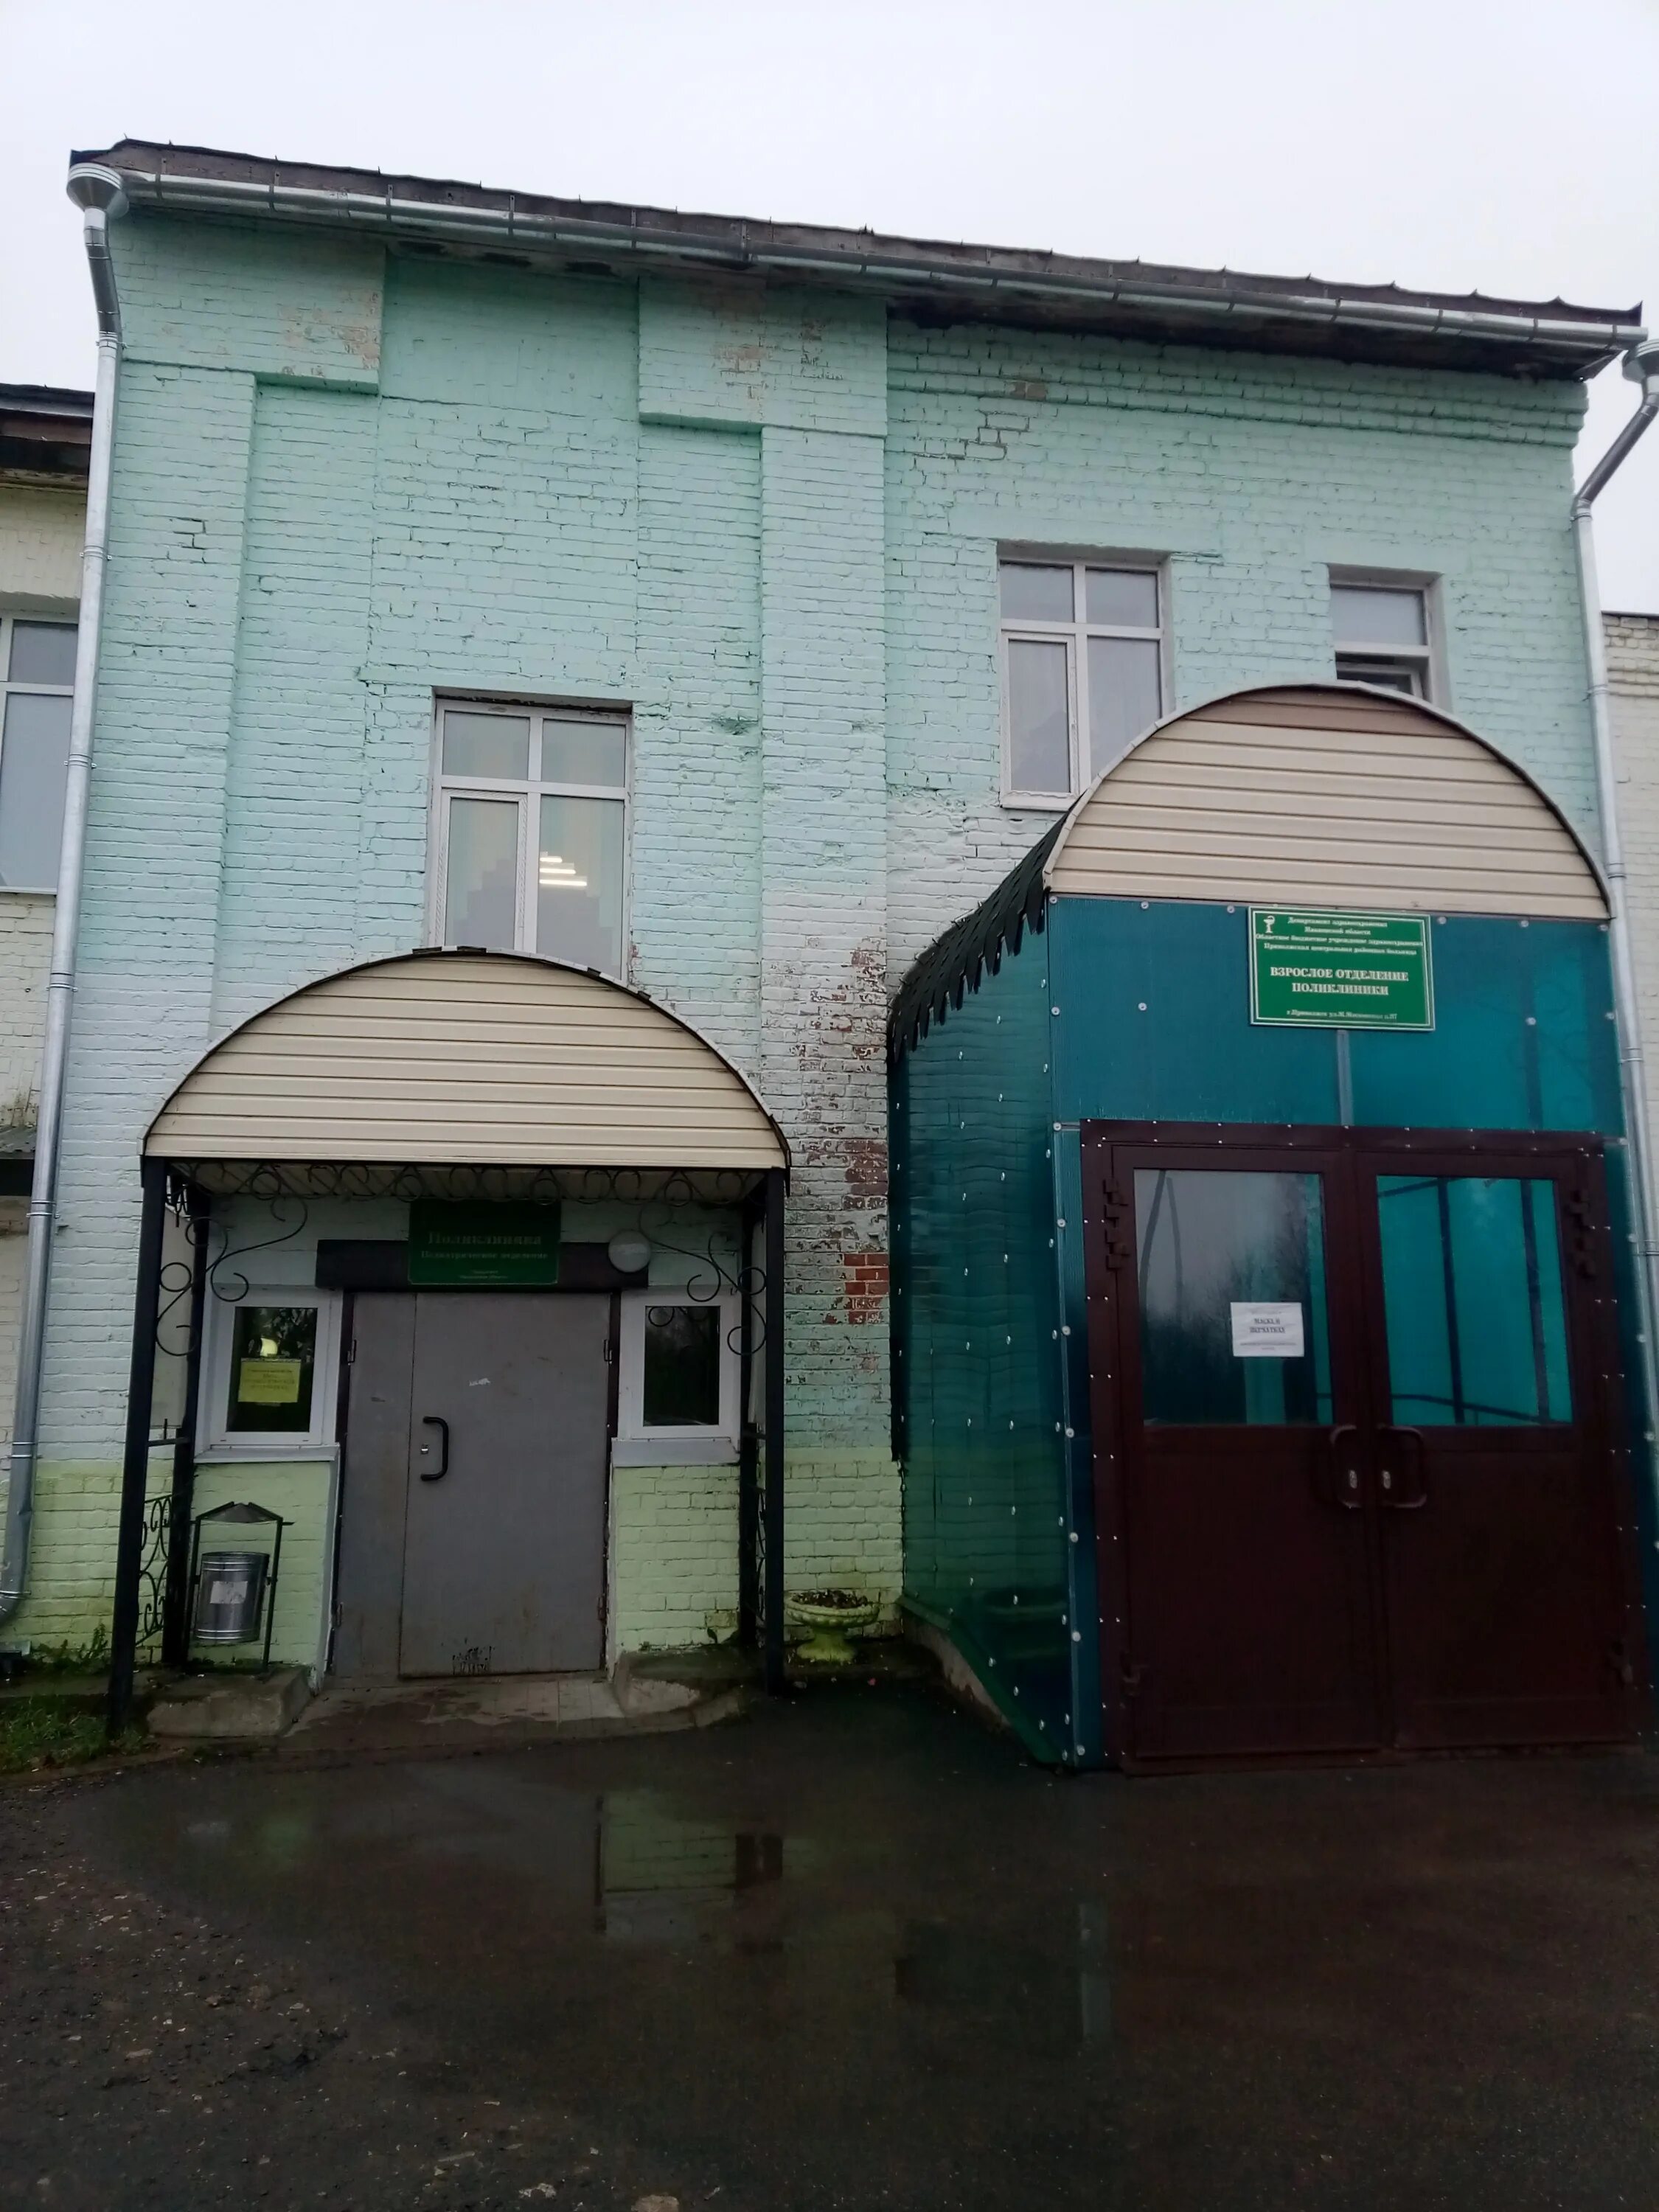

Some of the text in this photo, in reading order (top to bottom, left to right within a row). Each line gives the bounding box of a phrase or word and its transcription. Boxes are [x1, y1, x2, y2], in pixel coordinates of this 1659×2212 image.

[1270, 967, 1409, 981] ВЗРОСЛОЕ ОТДЕЛЕНИЕ
[1292, 982, 1388, 995] ПОЛИКЛИНИКИ
[428, 1232, 541, 1245] Поликлиника
